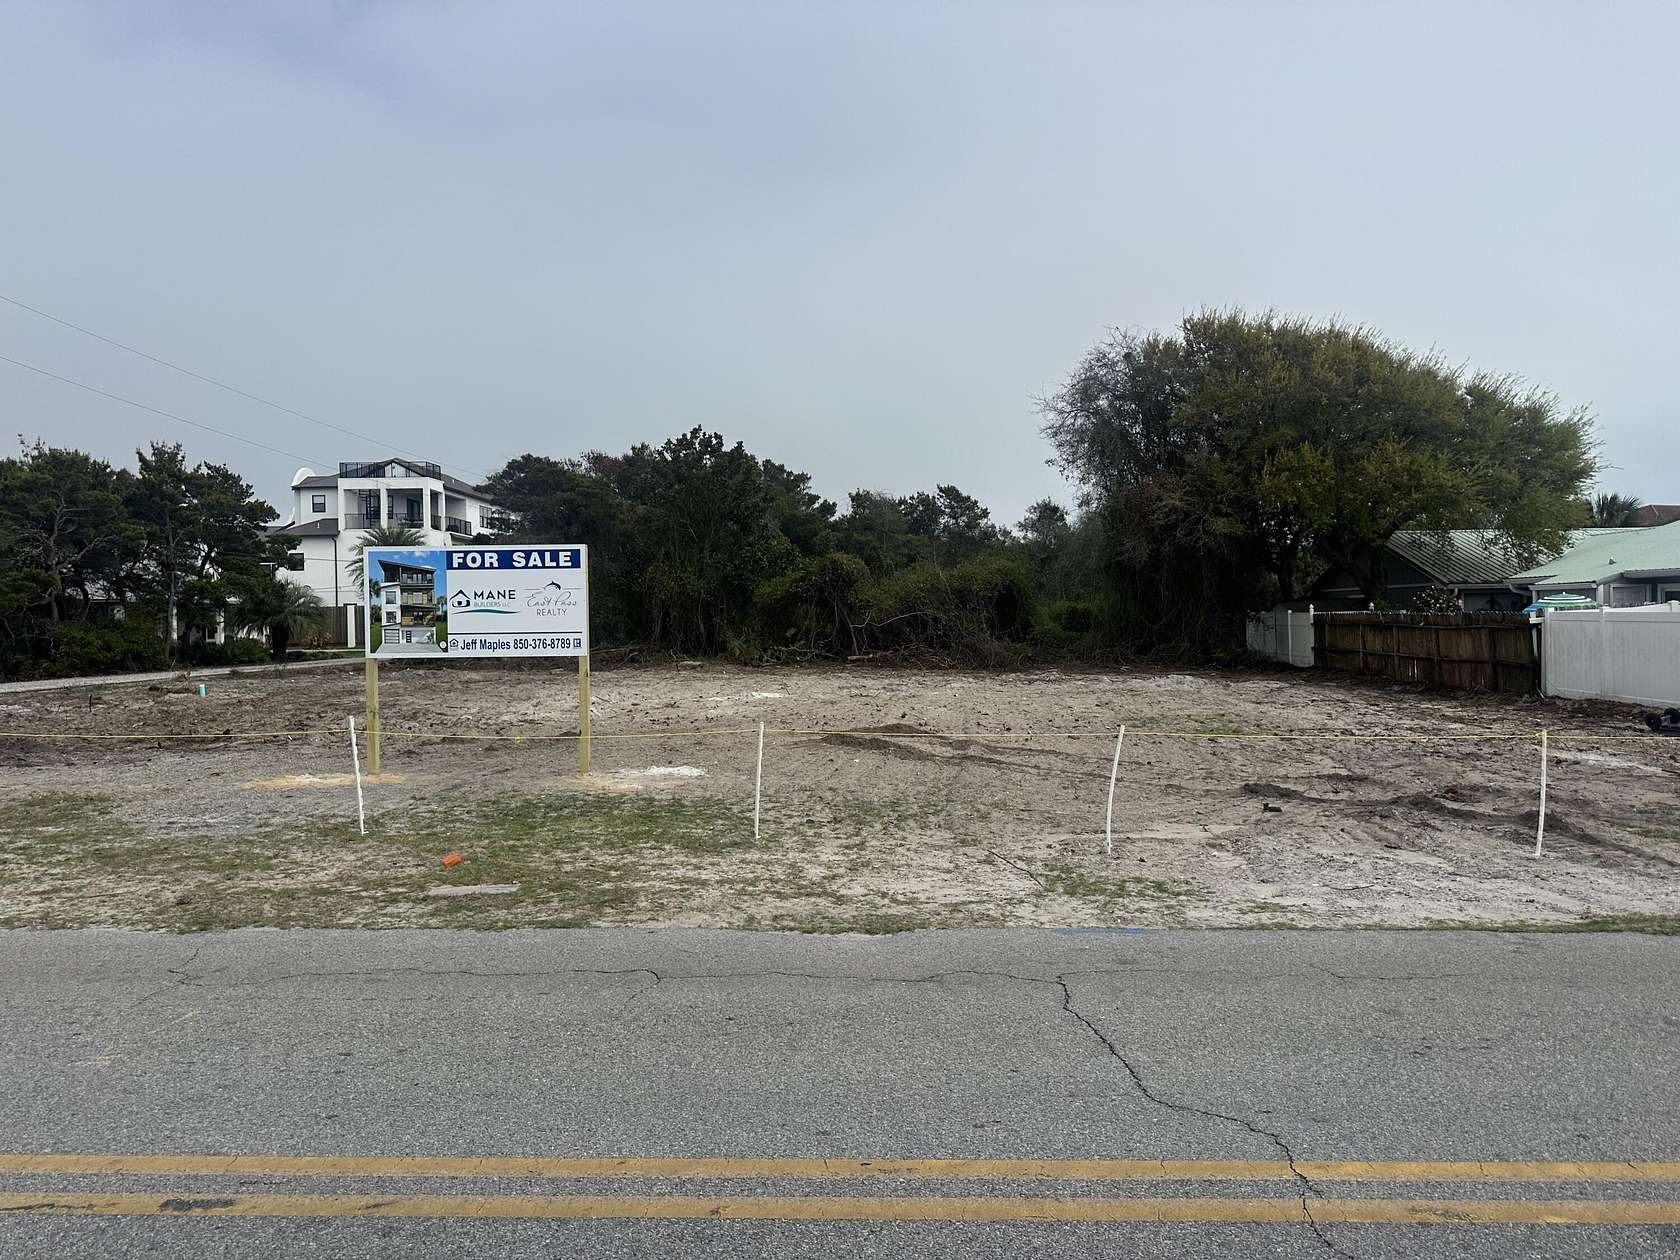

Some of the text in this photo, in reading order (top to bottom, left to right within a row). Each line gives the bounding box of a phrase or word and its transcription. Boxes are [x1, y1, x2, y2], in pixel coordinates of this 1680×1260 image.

[453, 552, 572, 567] FOR SALE
[474, 590, 516, 600] MANE
[461, 639, 477, 650] Jeff
[480, 639, 511, 652] Maples
[513, 638, 570, 650] 850-376-8789
